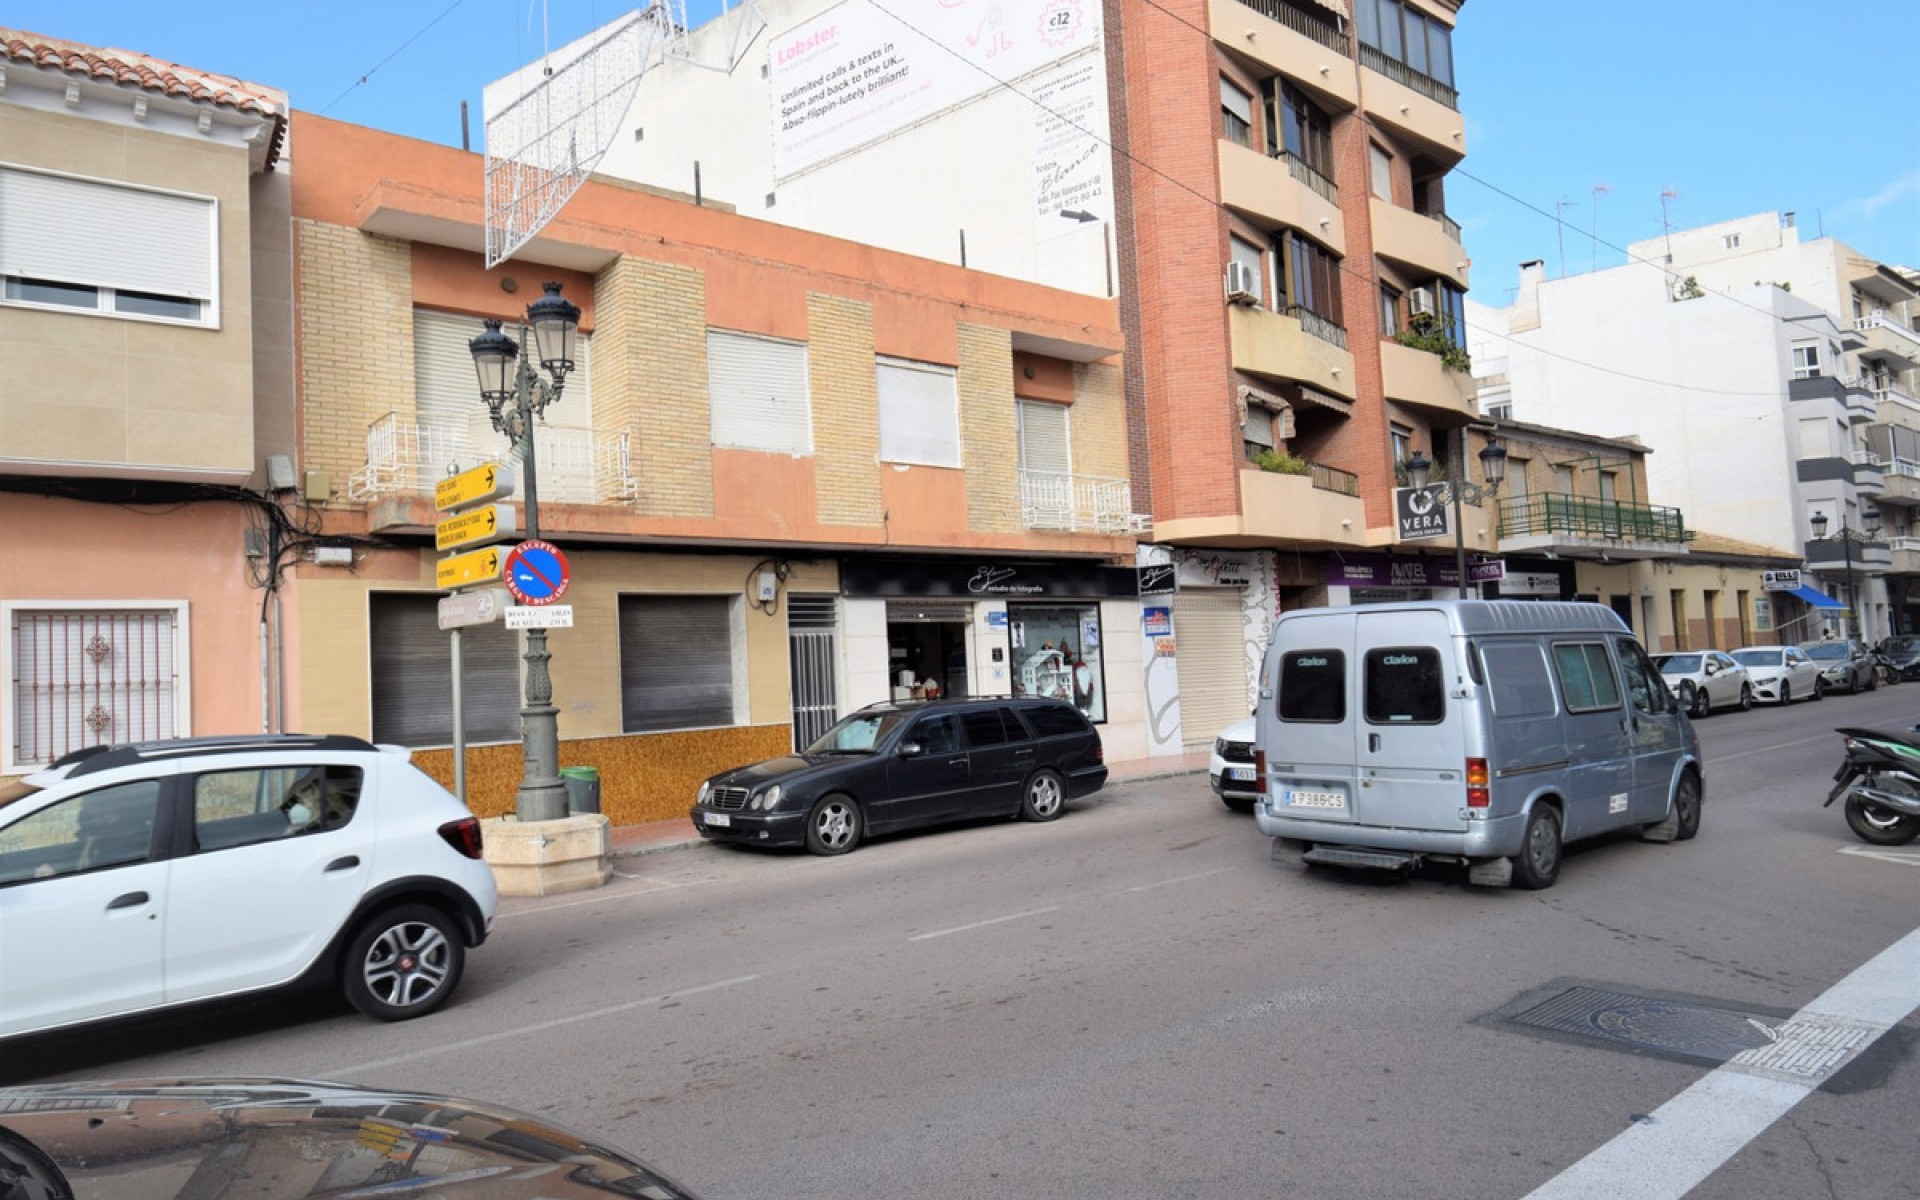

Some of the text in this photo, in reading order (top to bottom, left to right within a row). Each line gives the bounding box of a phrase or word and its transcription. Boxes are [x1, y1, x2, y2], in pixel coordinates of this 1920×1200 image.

[781, 76, 824, 104] Unlimited
[825, 67, 847, 82] calls
[849, 62, 856, 72] &
[858, 49, 883, 67] texts
[884, 42, 894, 56] in
[868, 65, 909, 92] brilliant!
[781, 101, 806, 119] Spain
[808, 91, 825, 106] and
[826, 80, 848, 97] back
[852, 75, 862, 84] to
[863, 64, 881, 79] the
[1402, 515, 1442, 530] VERA
[517, 542, 557, 554] EXCEPTO
